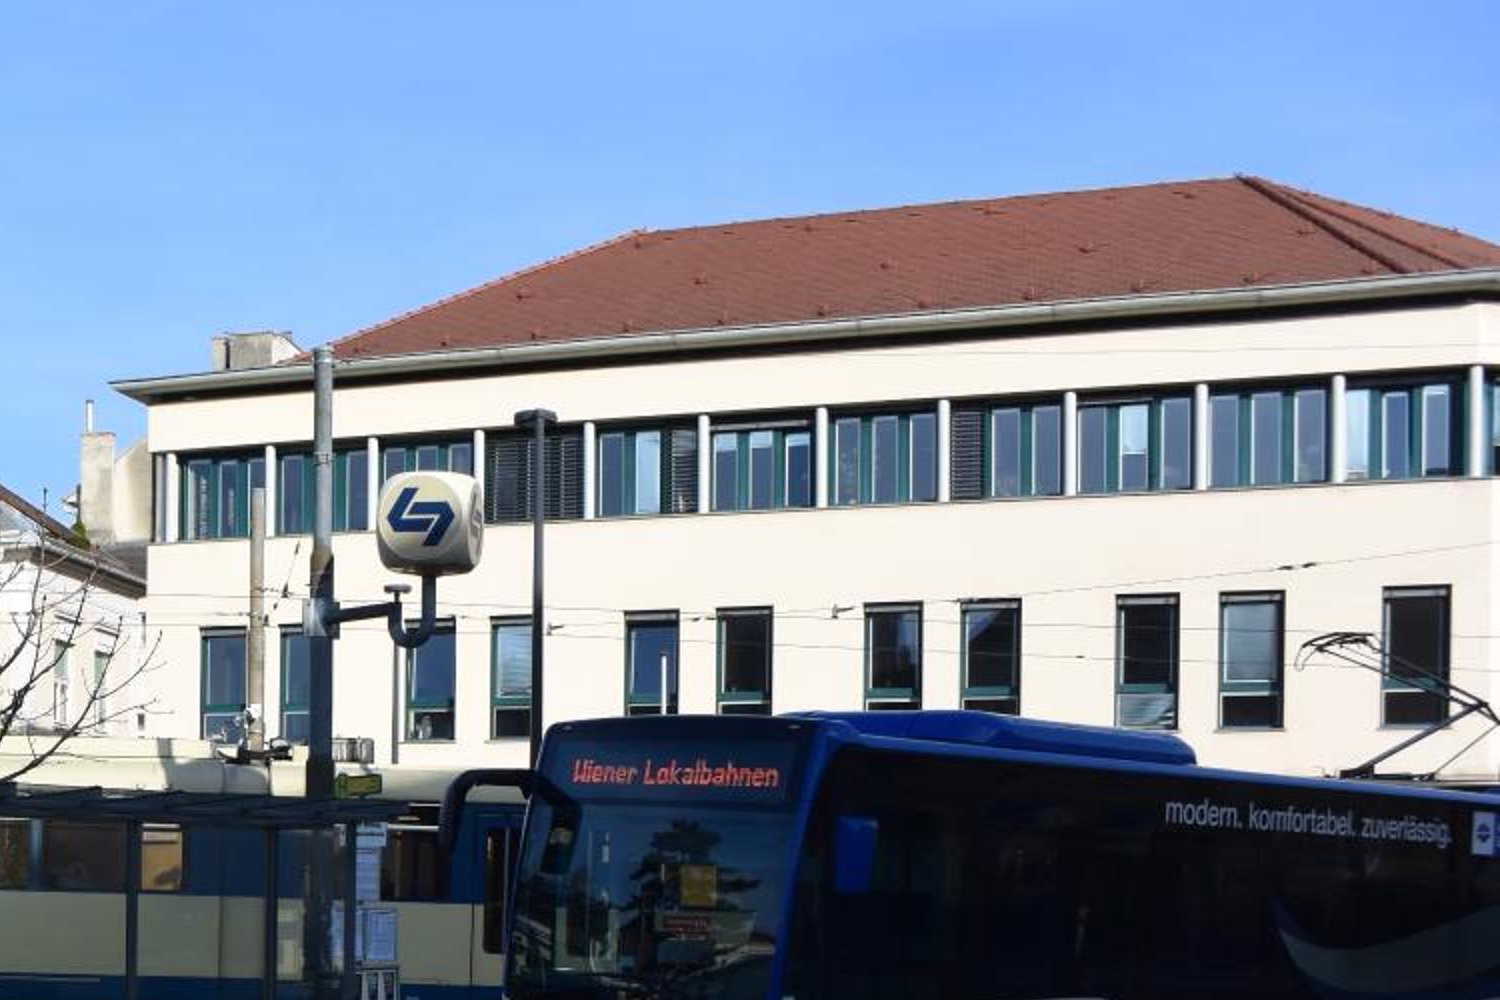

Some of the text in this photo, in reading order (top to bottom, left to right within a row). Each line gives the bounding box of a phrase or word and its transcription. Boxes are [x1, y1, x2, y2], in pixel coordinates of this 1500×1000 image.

[573, 758, 779, 788] Wiener Lokalbahnen
[1164, 799, 1453, 849] modern. komfortabel. zuverlässig.
